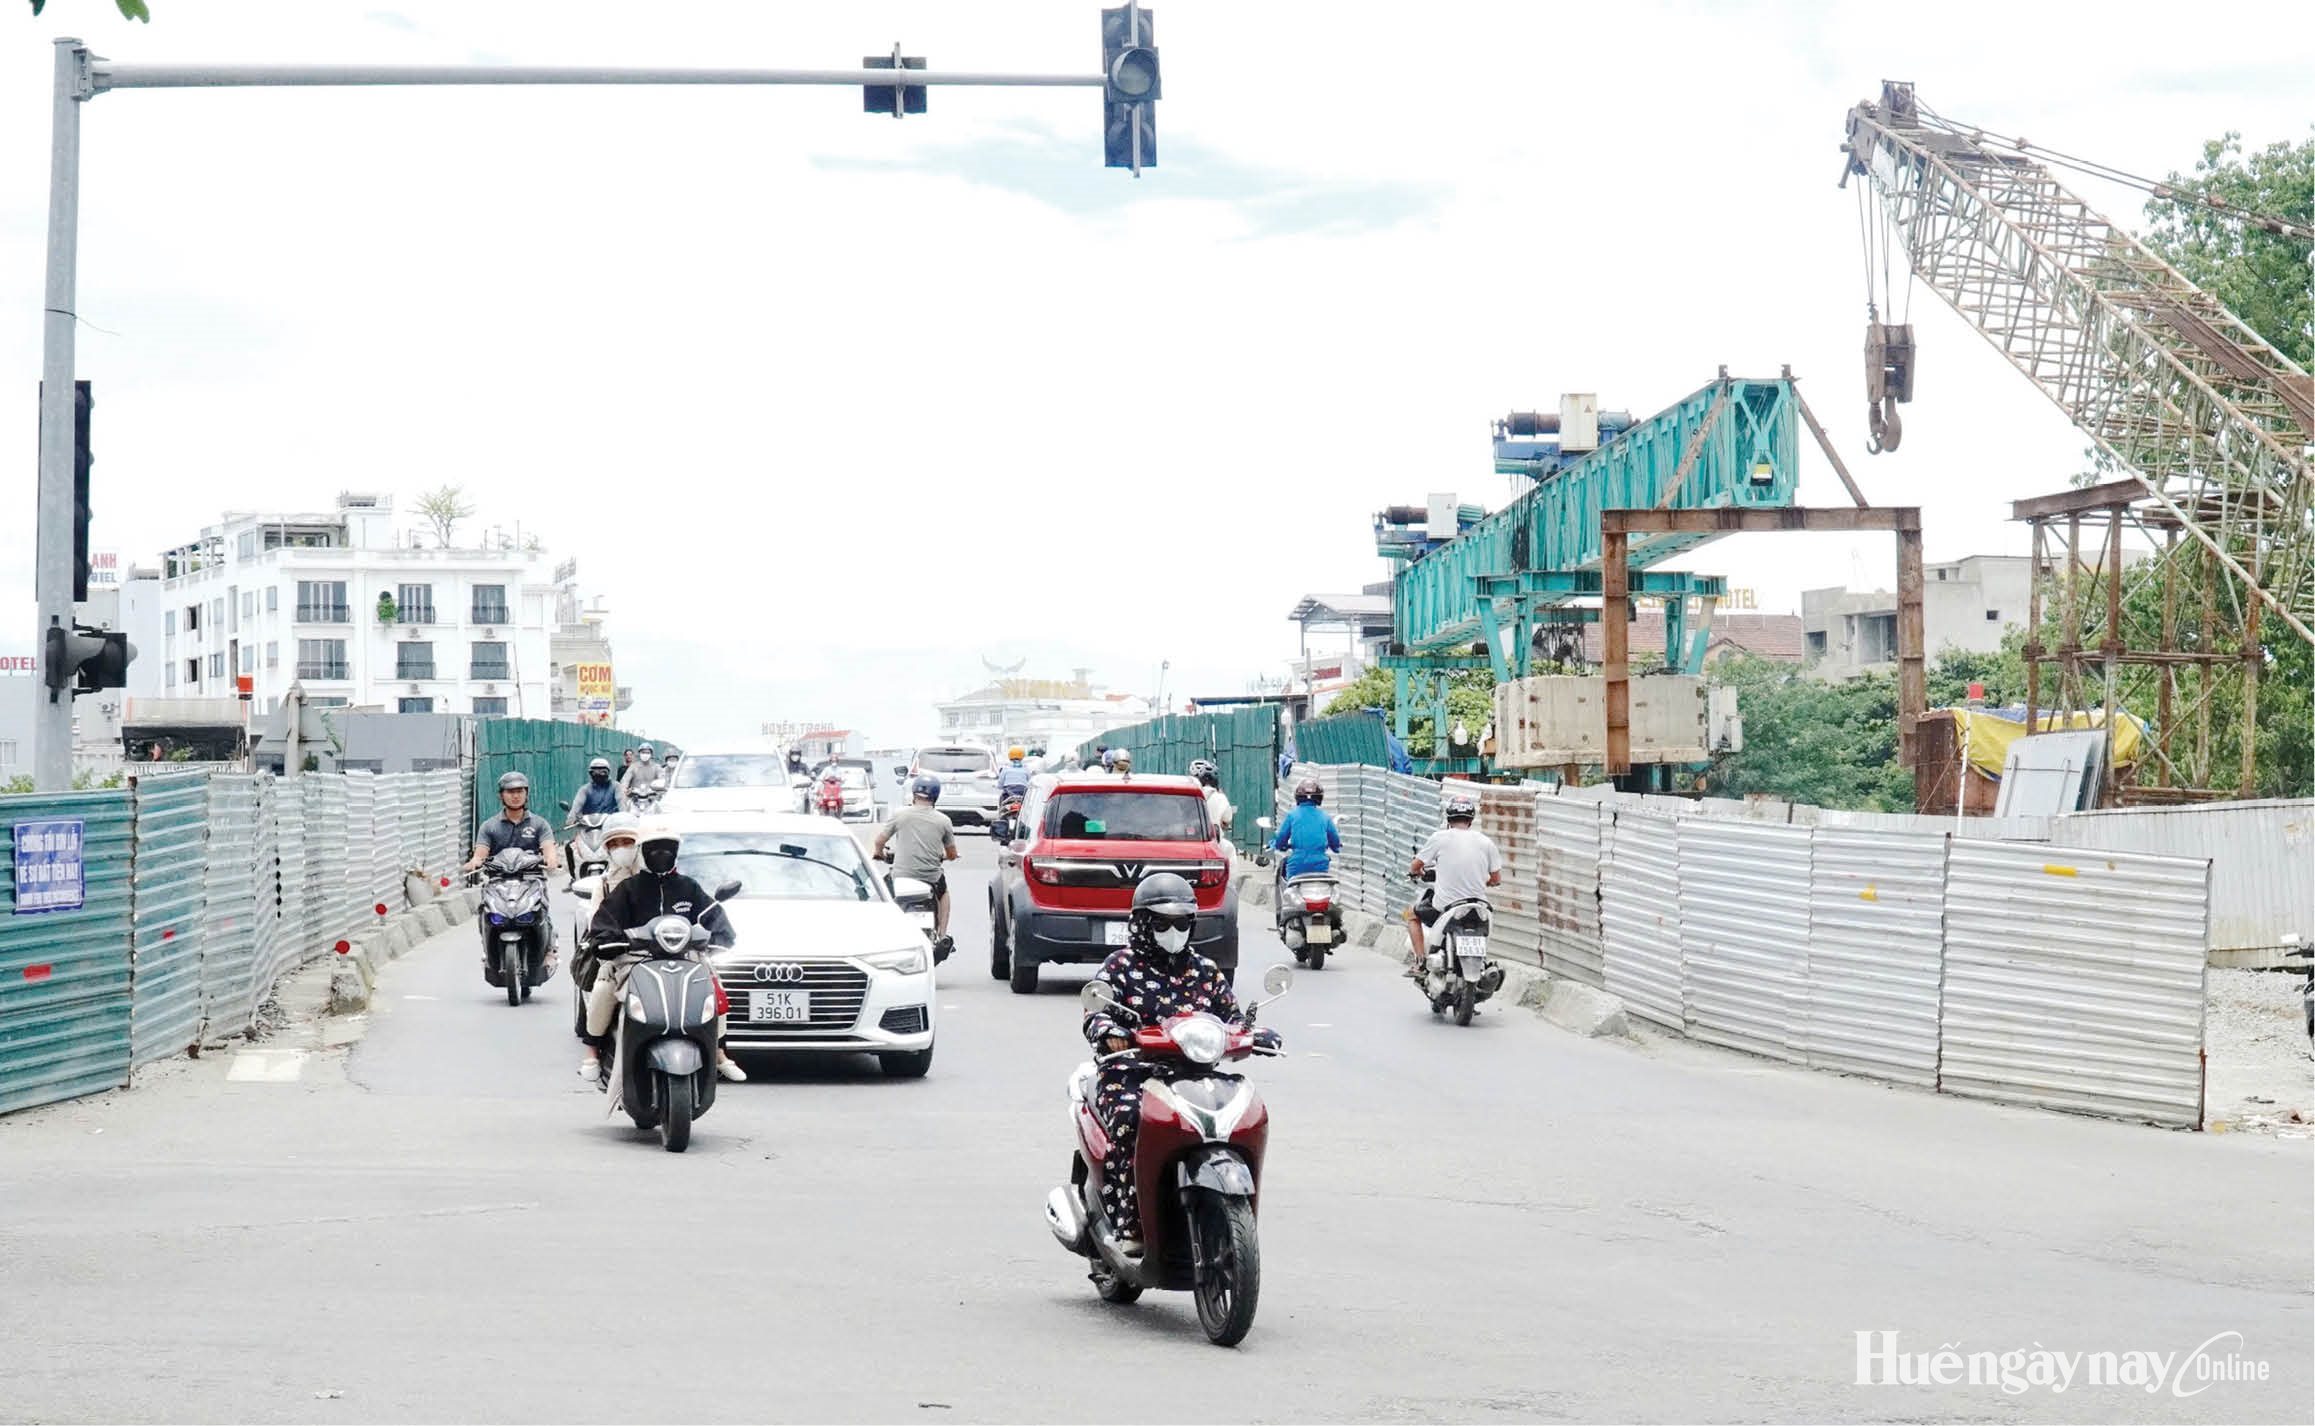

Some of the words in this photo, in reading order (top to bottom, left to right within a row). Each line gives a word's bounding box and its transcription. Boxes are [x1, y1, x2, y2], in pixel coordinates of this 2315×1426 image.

[88, 571, 117, 583] OTEL
[0, 656, 38, 671] OTEL
[767, 993, 792, 1006] 51K
[757, 1006, 802, 1020] 396.01
